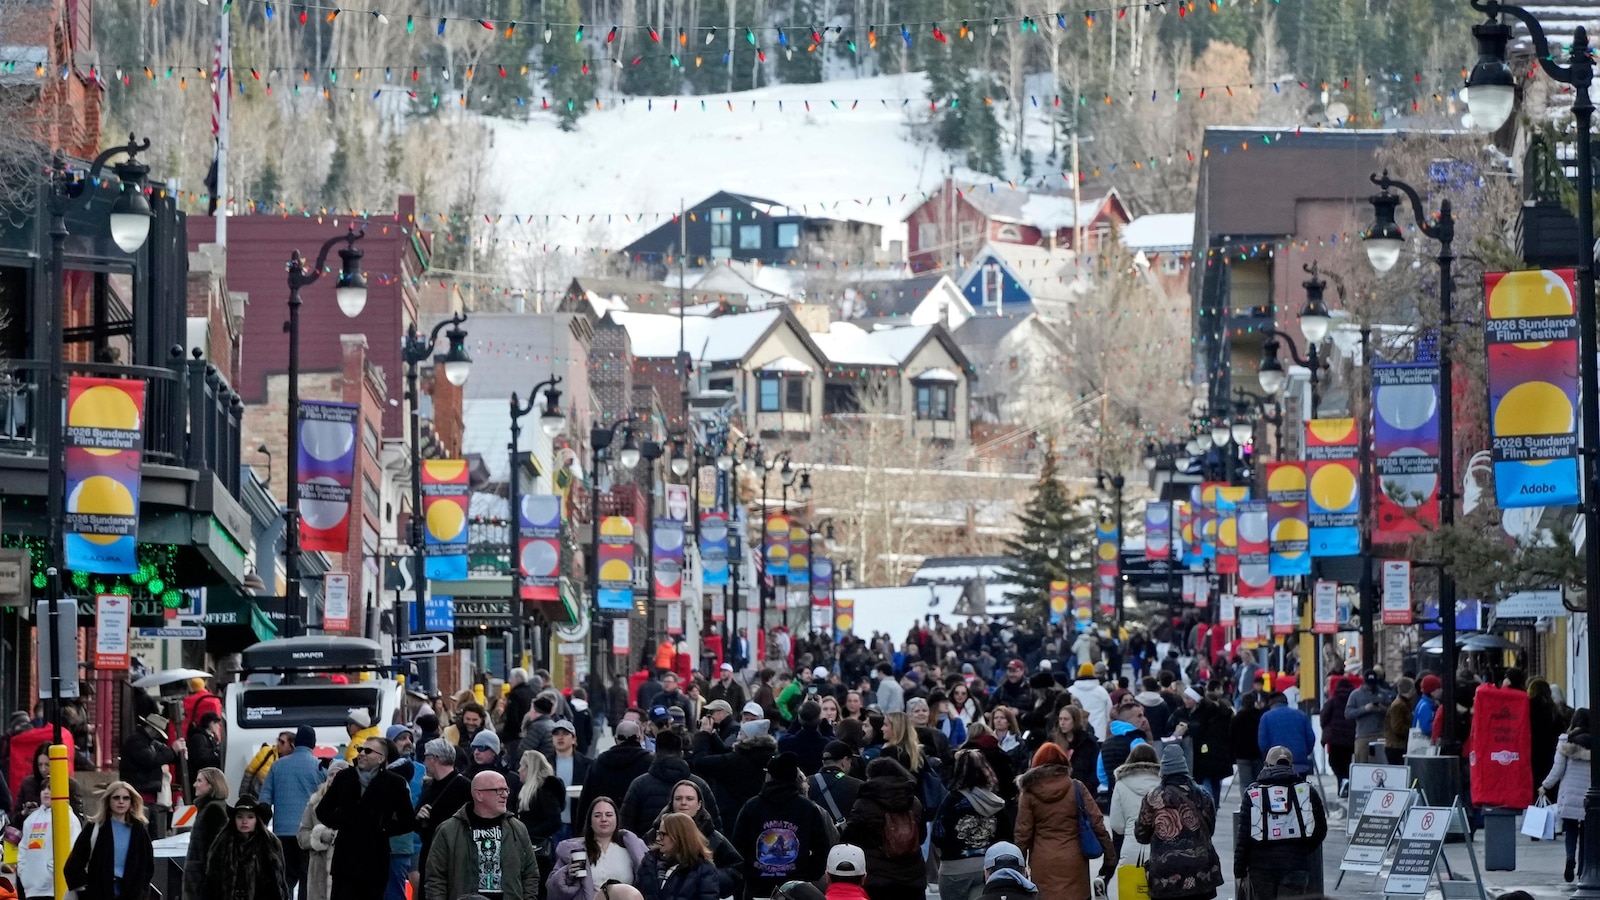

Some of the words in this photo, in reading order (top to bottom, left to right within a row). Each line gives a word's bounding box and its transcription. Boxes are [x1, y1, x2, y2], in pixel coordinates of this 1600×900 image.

[1487, 320, 1516, 331] 2026
[1518, 318, 1576, 330] Sundance
[1496, 330, 1521, 341] Film
[1524, 328, 1568, 340] Festival
[1374, 369, 1394, 377] 2026
[1396, 368, 1438, 376] Sundance
[1380, 376, 1398, 384] Film
[1400, 374, 1432, 384] Festival
[68, 428, 90, 437] 2026
[92, 428, 140, 440] Sundance
[74, 436, 94, 445] Film
[96, 438, 133, 448] Festival
[1493, 438, 1522, 448] 2026
[1524, 436, 1575, 447] Sundance
[1502, 448, 1527, 459] Film
[1530, 446, 1569, 458] Festival
[1377, 458, 1398, 466] 2026
[1399, 457, 1438, 466] Sundance
[1383, 465, 1401, 473] Film
[1403, 464, 1434, 472] Festival
[1520, 483, 1556, 494] Adobe
[66, 514, 88, 524] 2026
[90, 516, 136, 526] Sundance
[74, 523, 92, 532] Film
[94, 524, 128, 533] Festival
